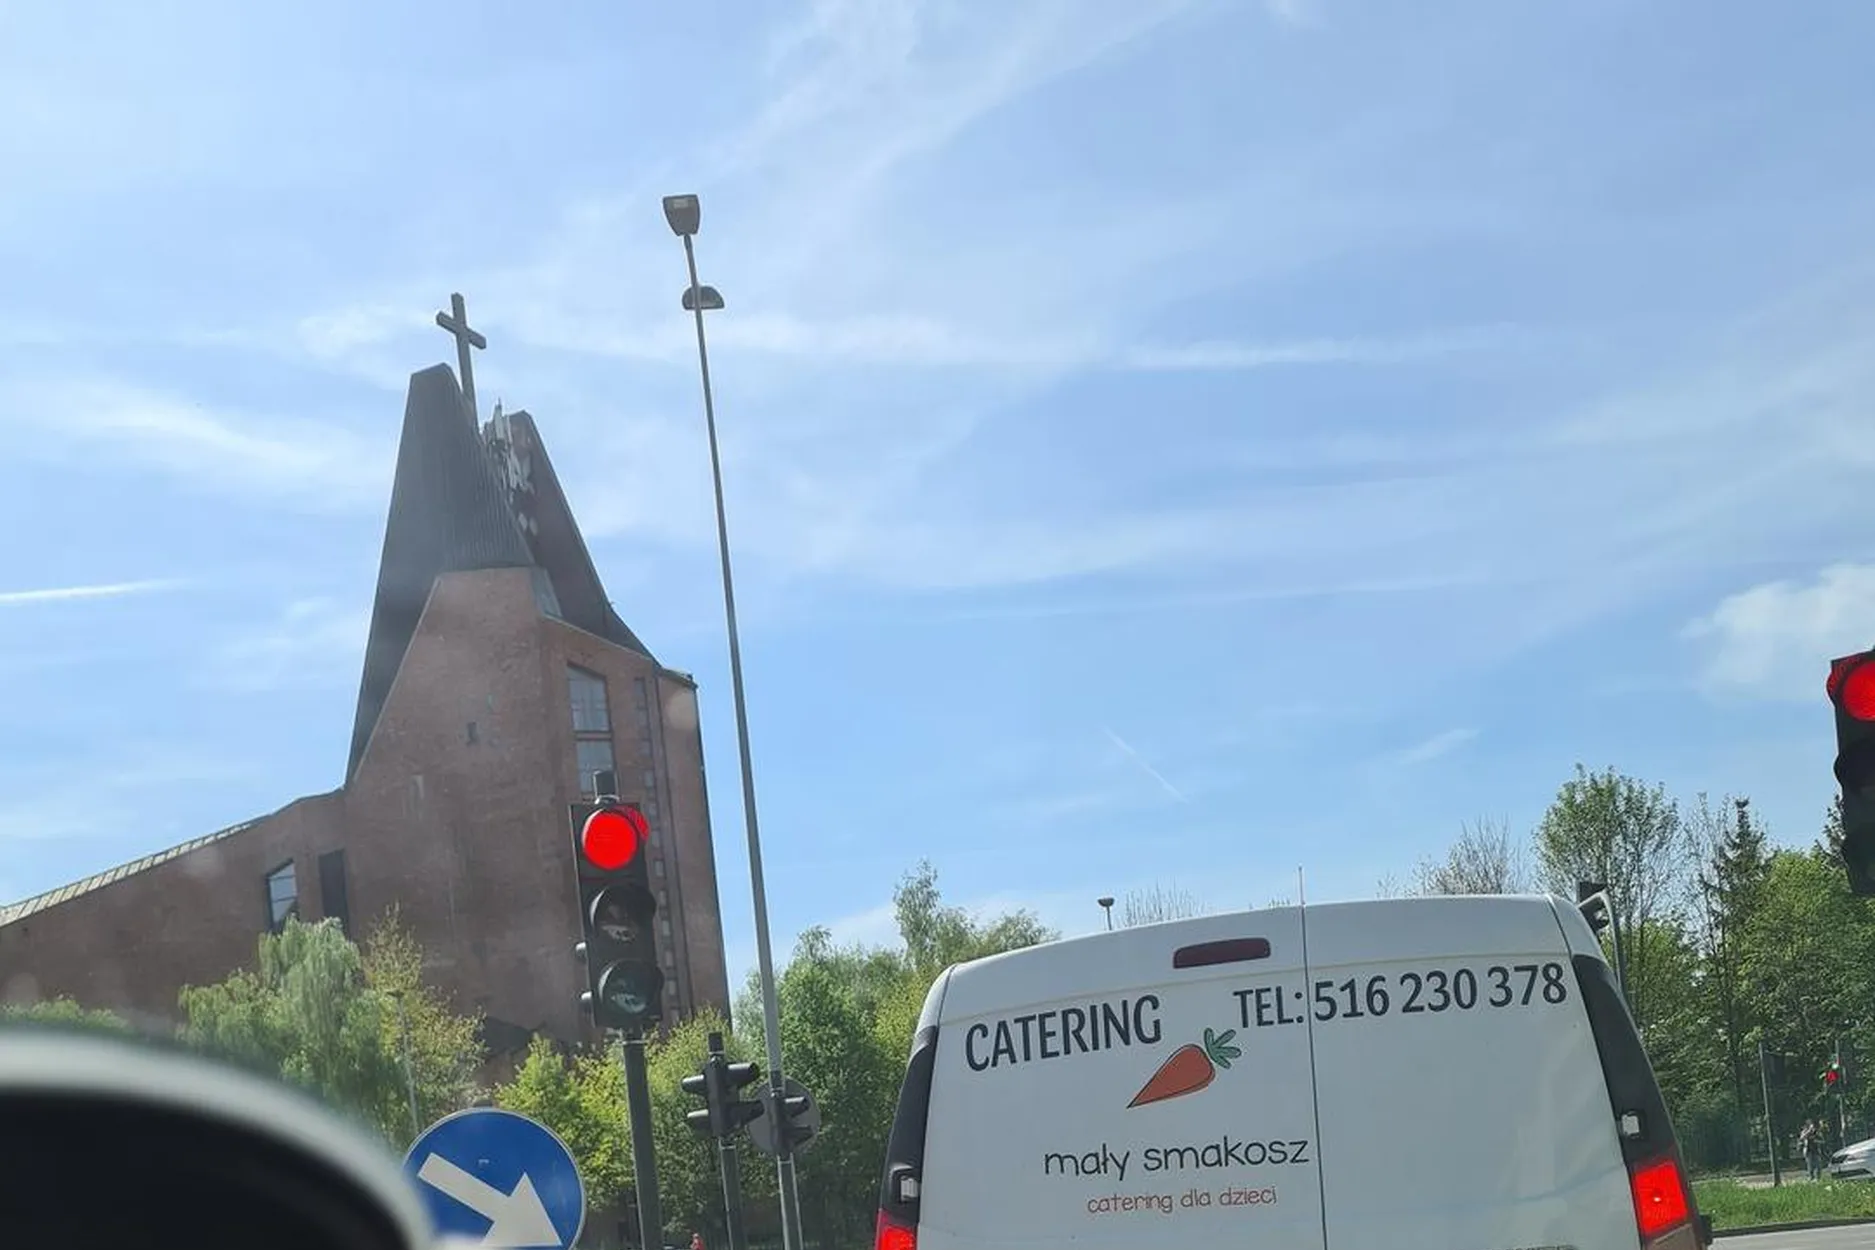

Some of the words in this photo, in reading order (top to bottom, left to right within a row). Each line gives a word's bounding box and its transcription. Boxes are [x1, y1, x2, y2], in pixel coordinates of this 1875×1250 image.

[1233, 985, 1304, 1028] TEL:
[1314, 974, 1390, 1021] 516
[1399, 968, 1478, 1014] 230
[1487, 962, 1567, 1008] 378
[965, 995, 1161, 1072] CATERING
[1044, 1143, 1130, 1181] mały
[1143, 1135, 1310, 1173] smakosz
[1087, 1192, 1173, 1213] catering
[1180, 1188, 1211, 1208] dla
[1219, 1185, 1277, 1206] dzieci
